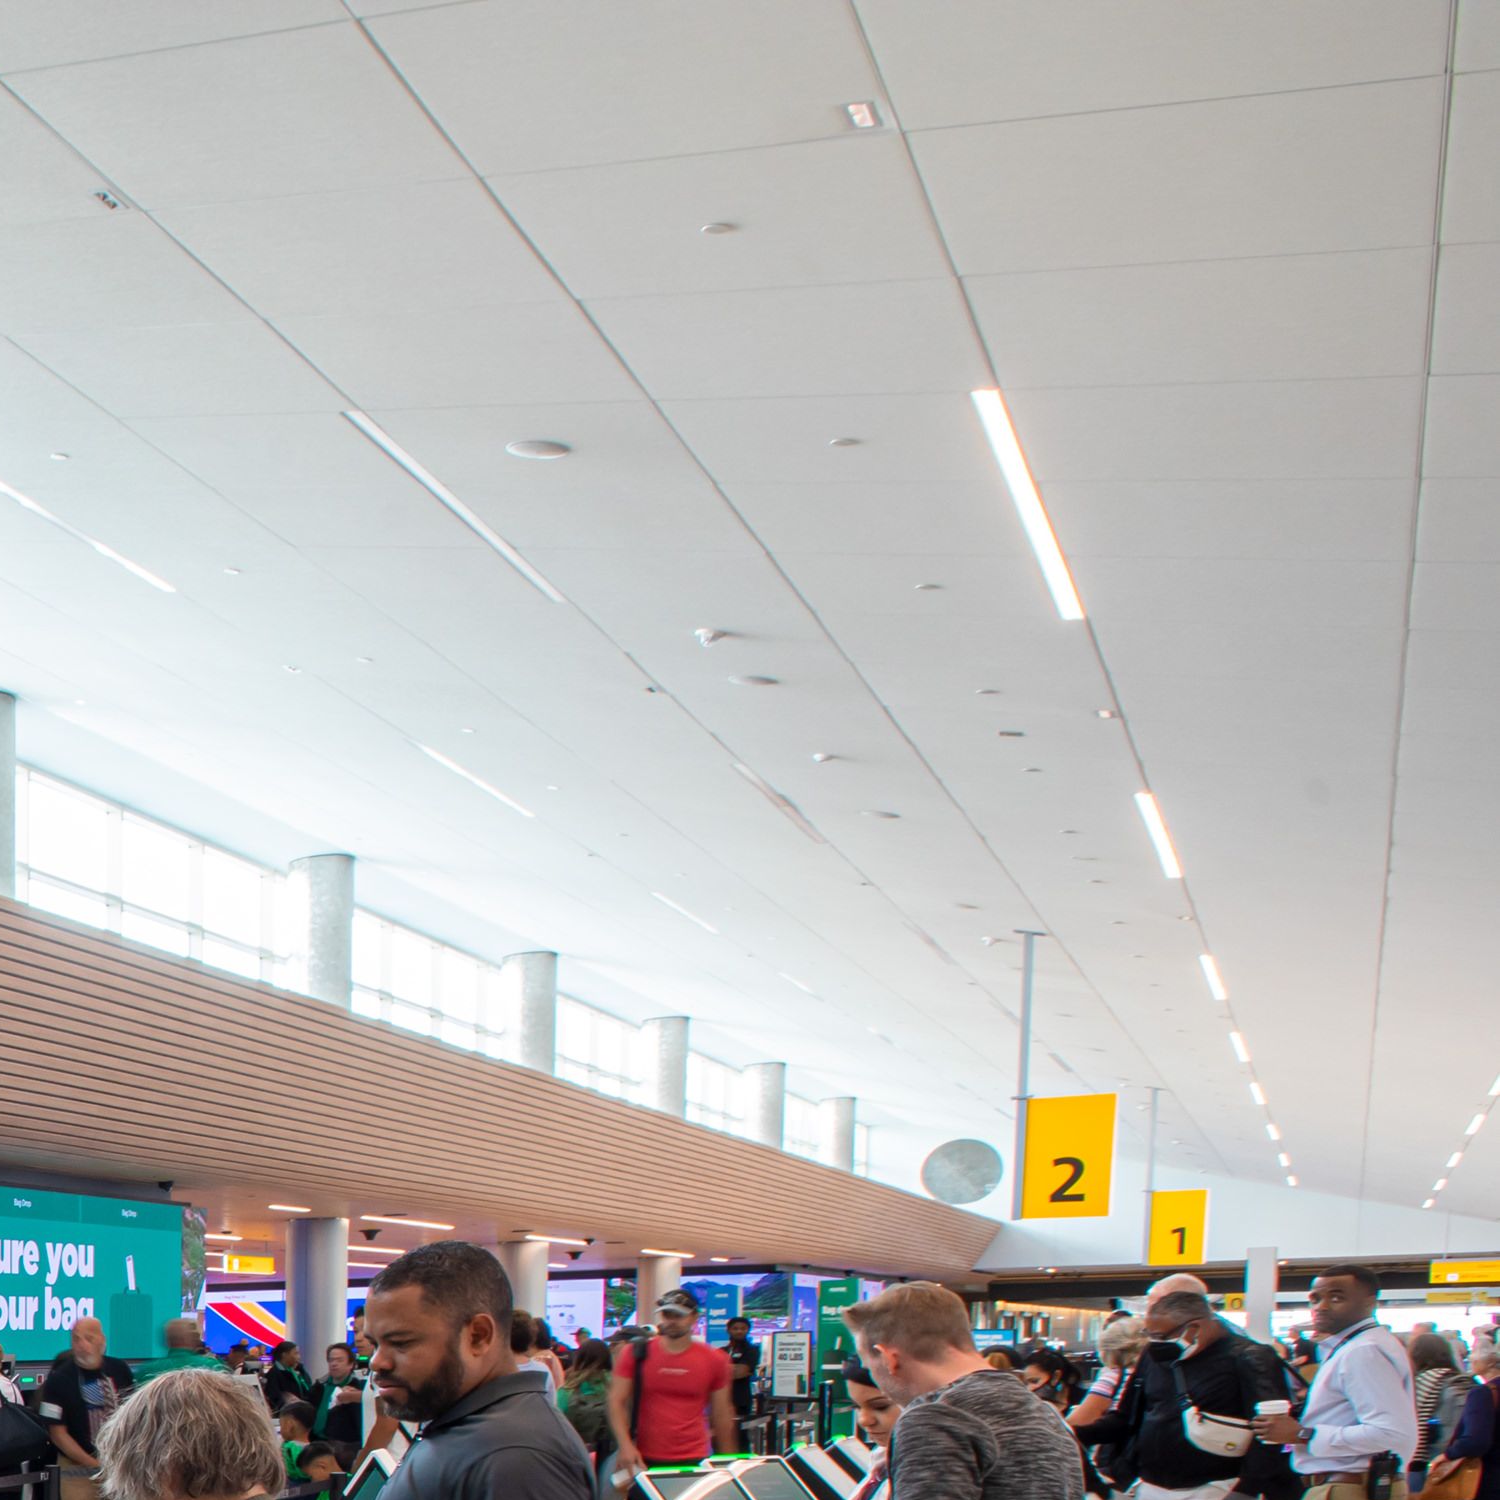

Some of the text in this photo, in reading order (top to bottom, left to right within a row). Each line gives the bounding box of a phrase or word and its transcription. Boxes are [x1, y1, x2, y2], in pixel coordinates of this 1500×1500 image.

[1049, 1157, 1086, 1203] 2
[1171, 1226, 1187, 1255] 1
[45, 1242, 94, 1285] you
